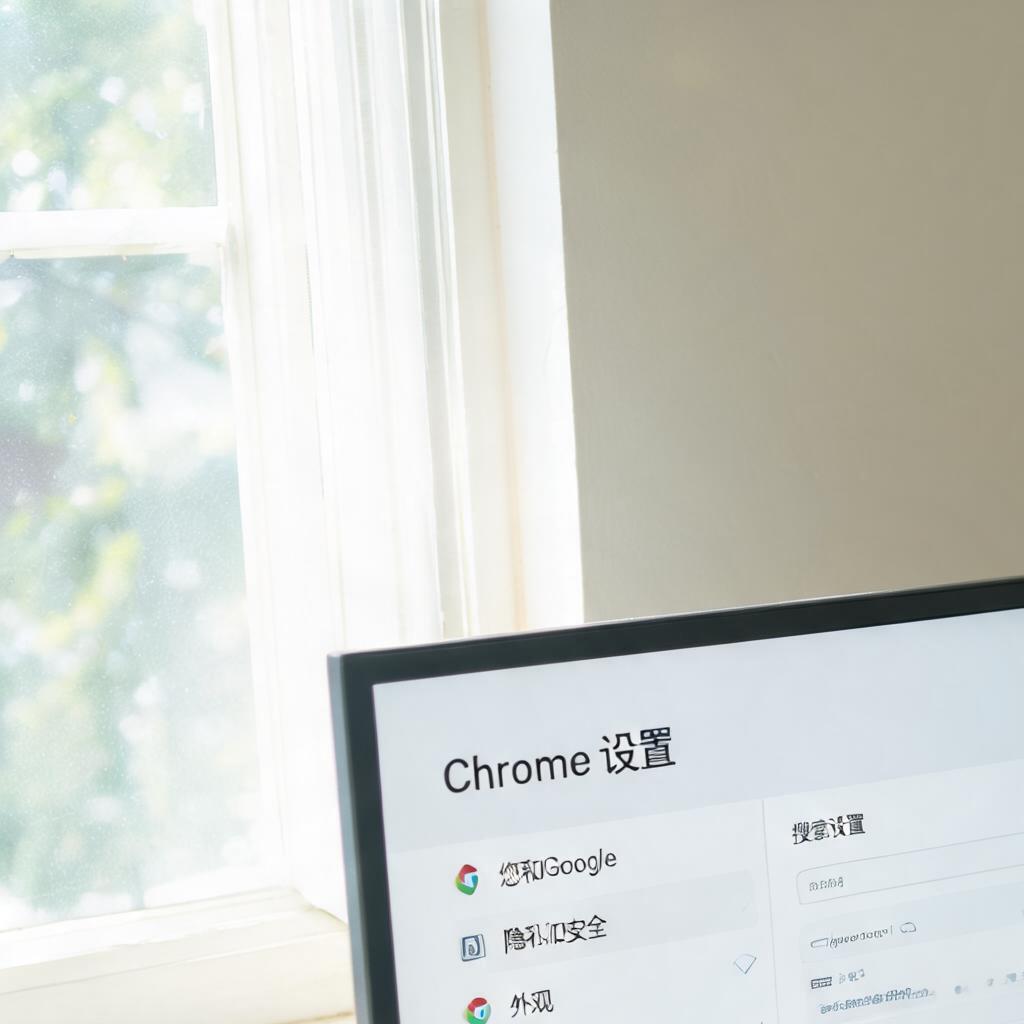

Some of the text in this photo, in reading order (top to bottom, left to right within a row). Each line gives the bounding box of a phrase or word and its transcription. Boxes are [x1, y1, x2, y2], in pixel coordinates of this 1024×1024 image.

[443, 726, 677, 794] Chrome 设置
[509, 989, 555, 1019] 外观
